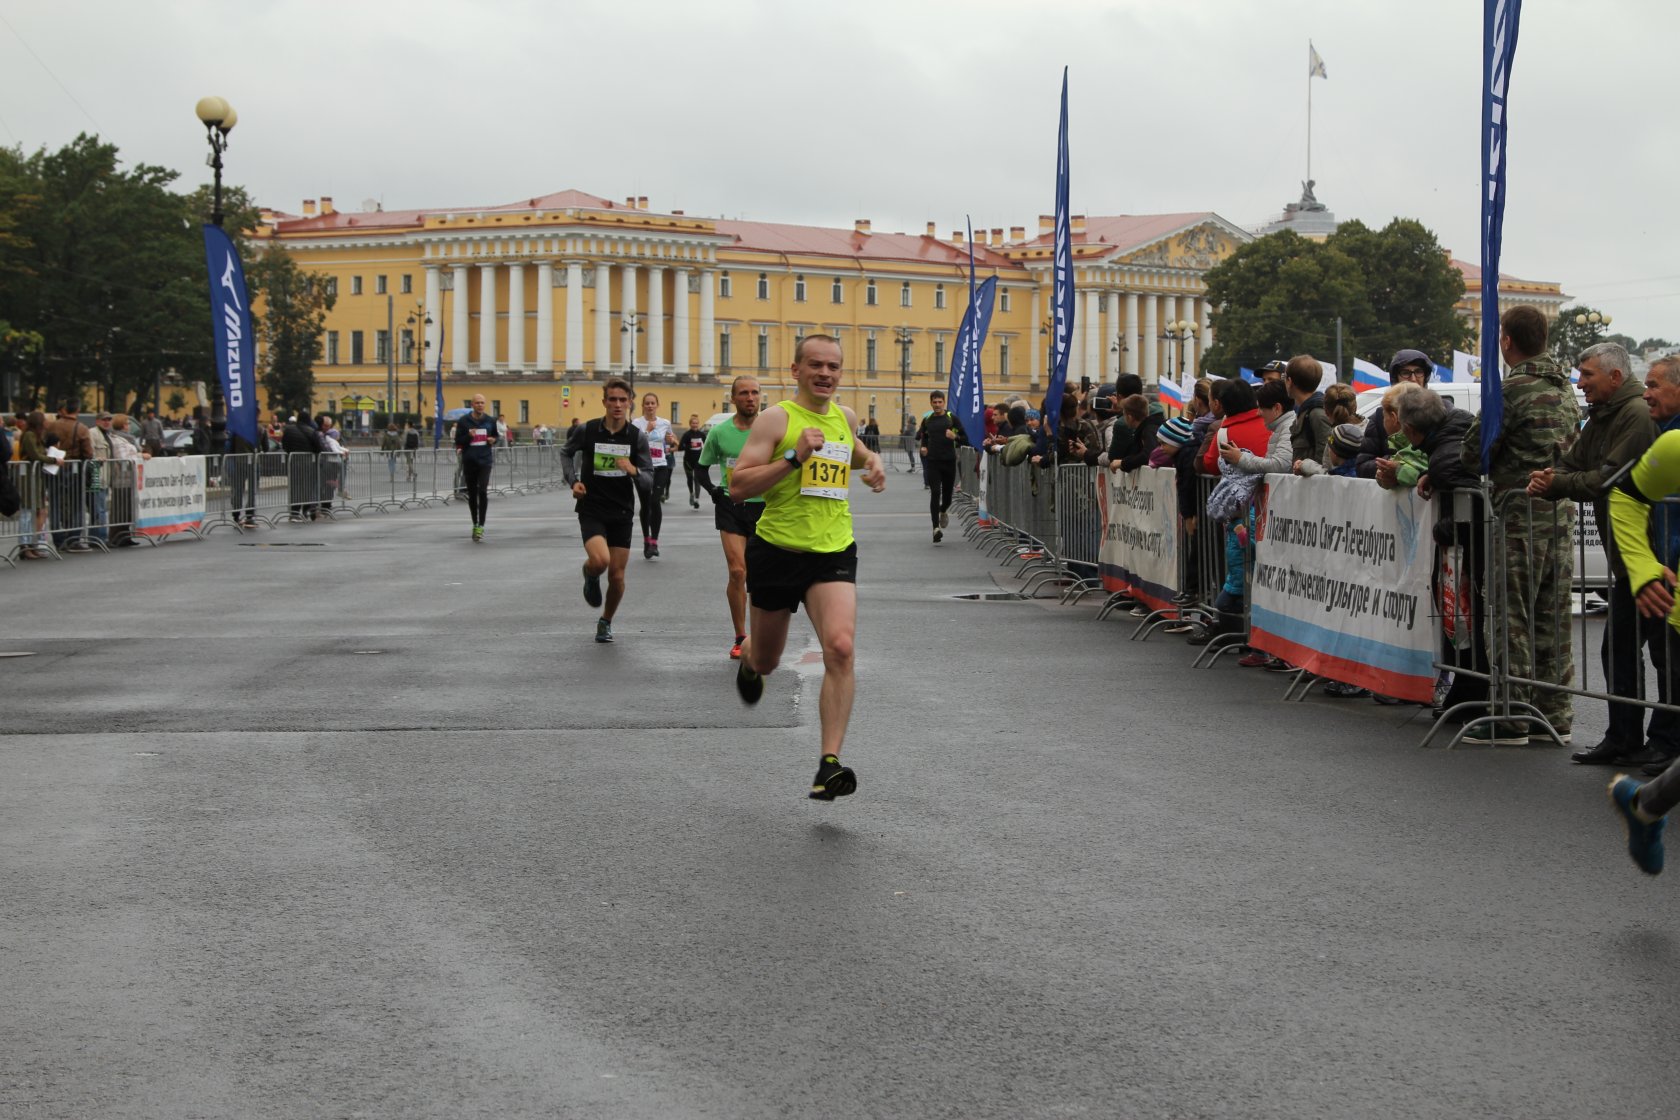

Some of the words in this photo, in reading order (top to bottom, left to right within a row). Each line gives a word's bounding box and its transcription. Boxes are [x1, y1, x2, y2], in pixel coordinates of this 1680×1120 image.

[809, 461, 847, 485] 1371
[1320, 516, 1396, 566] Санкт-Петербурга
[1371, 588, 1382, 616] и
[1383, 590, 1418, 631] спорту
